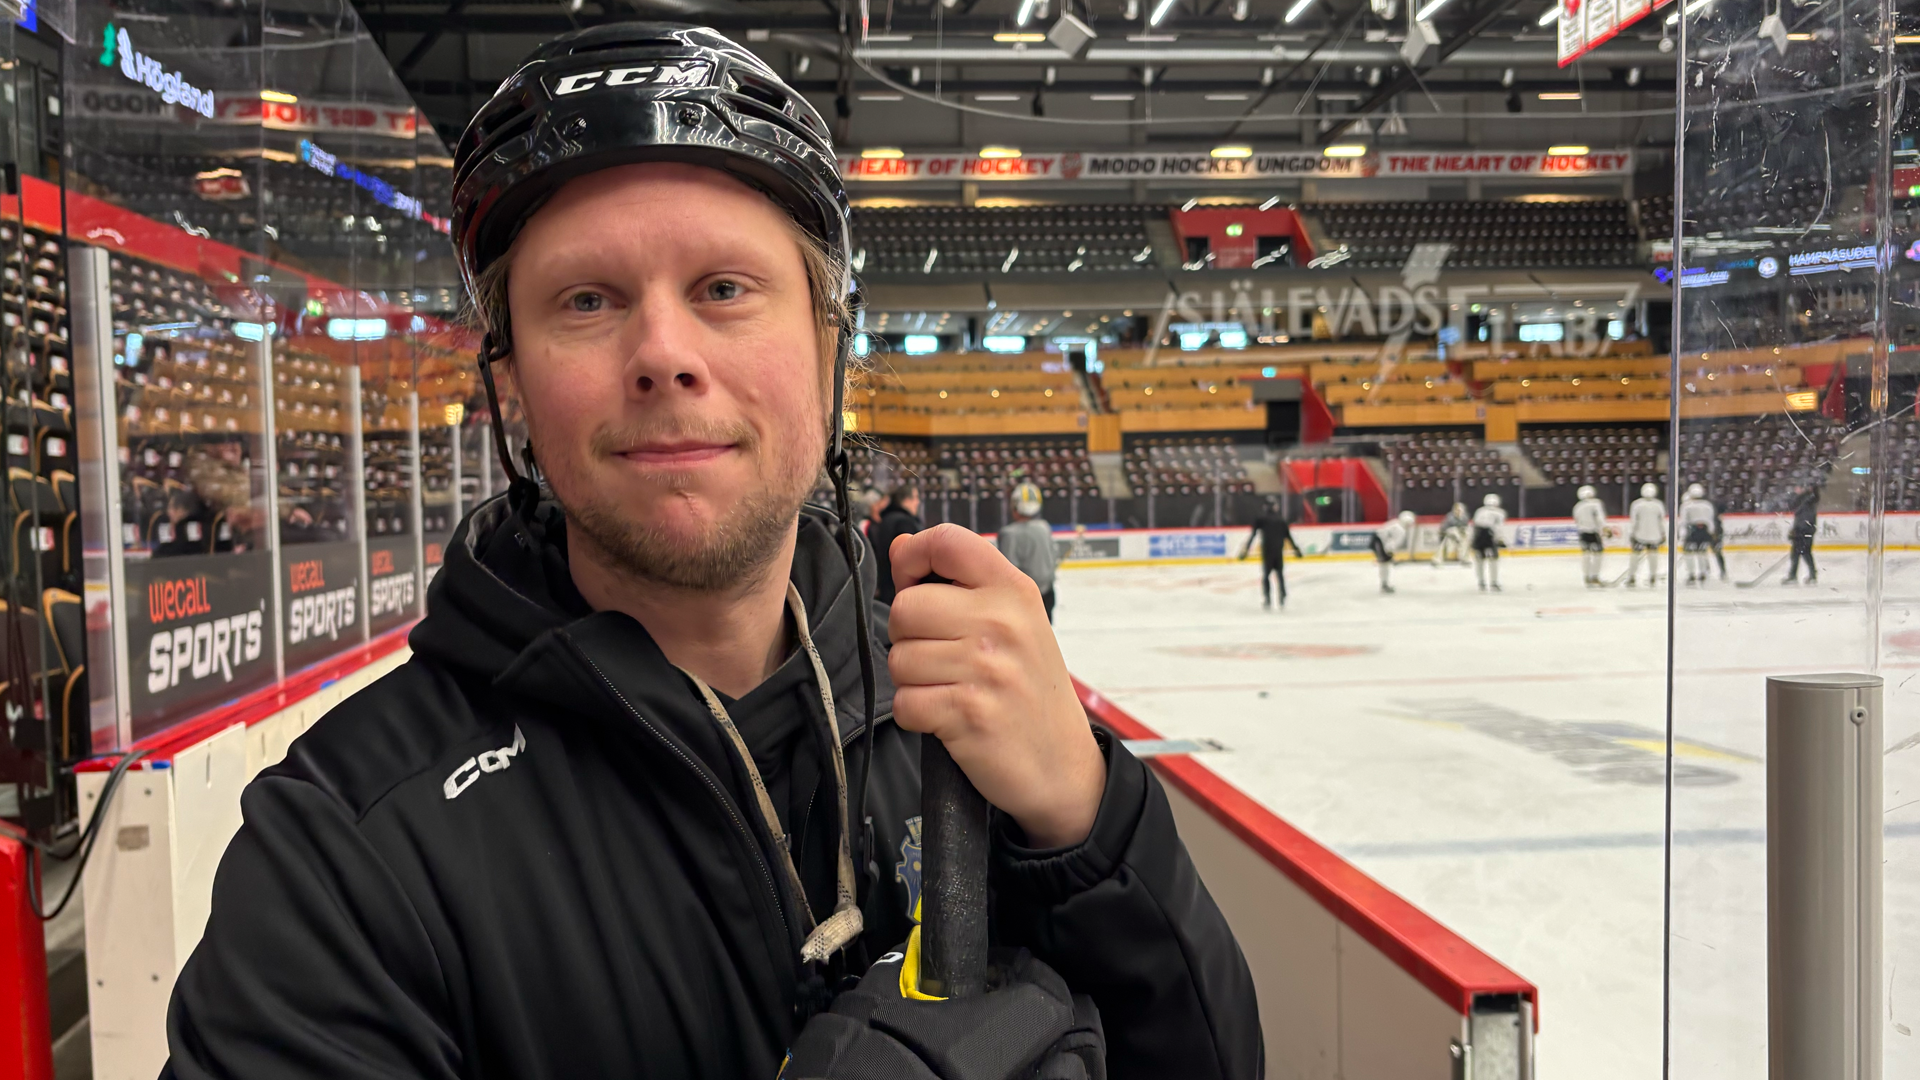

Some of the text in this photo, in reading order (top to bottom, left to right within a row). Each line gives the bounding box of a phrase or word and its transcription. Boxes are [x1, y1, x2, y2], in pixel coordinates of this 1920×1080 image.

[135, 51, 214, 119] Högland
[555, 66, 710, 96] CCM
[850, 158, 920, 175] HEART
[929, 158, 955, 175] OF
[962, 157, 1054, 175] HOCKEY
[1089, 155, 1353, 174] MODO HOCKEY UNGDOM
[1388, 153, 1629, 172] THE HEART OF HOCKEY
[371, 571, 415, 616] SPORTS
[290, 585, 356, 644] SPORTS
[148, 609, 262, 694] SPORTS
